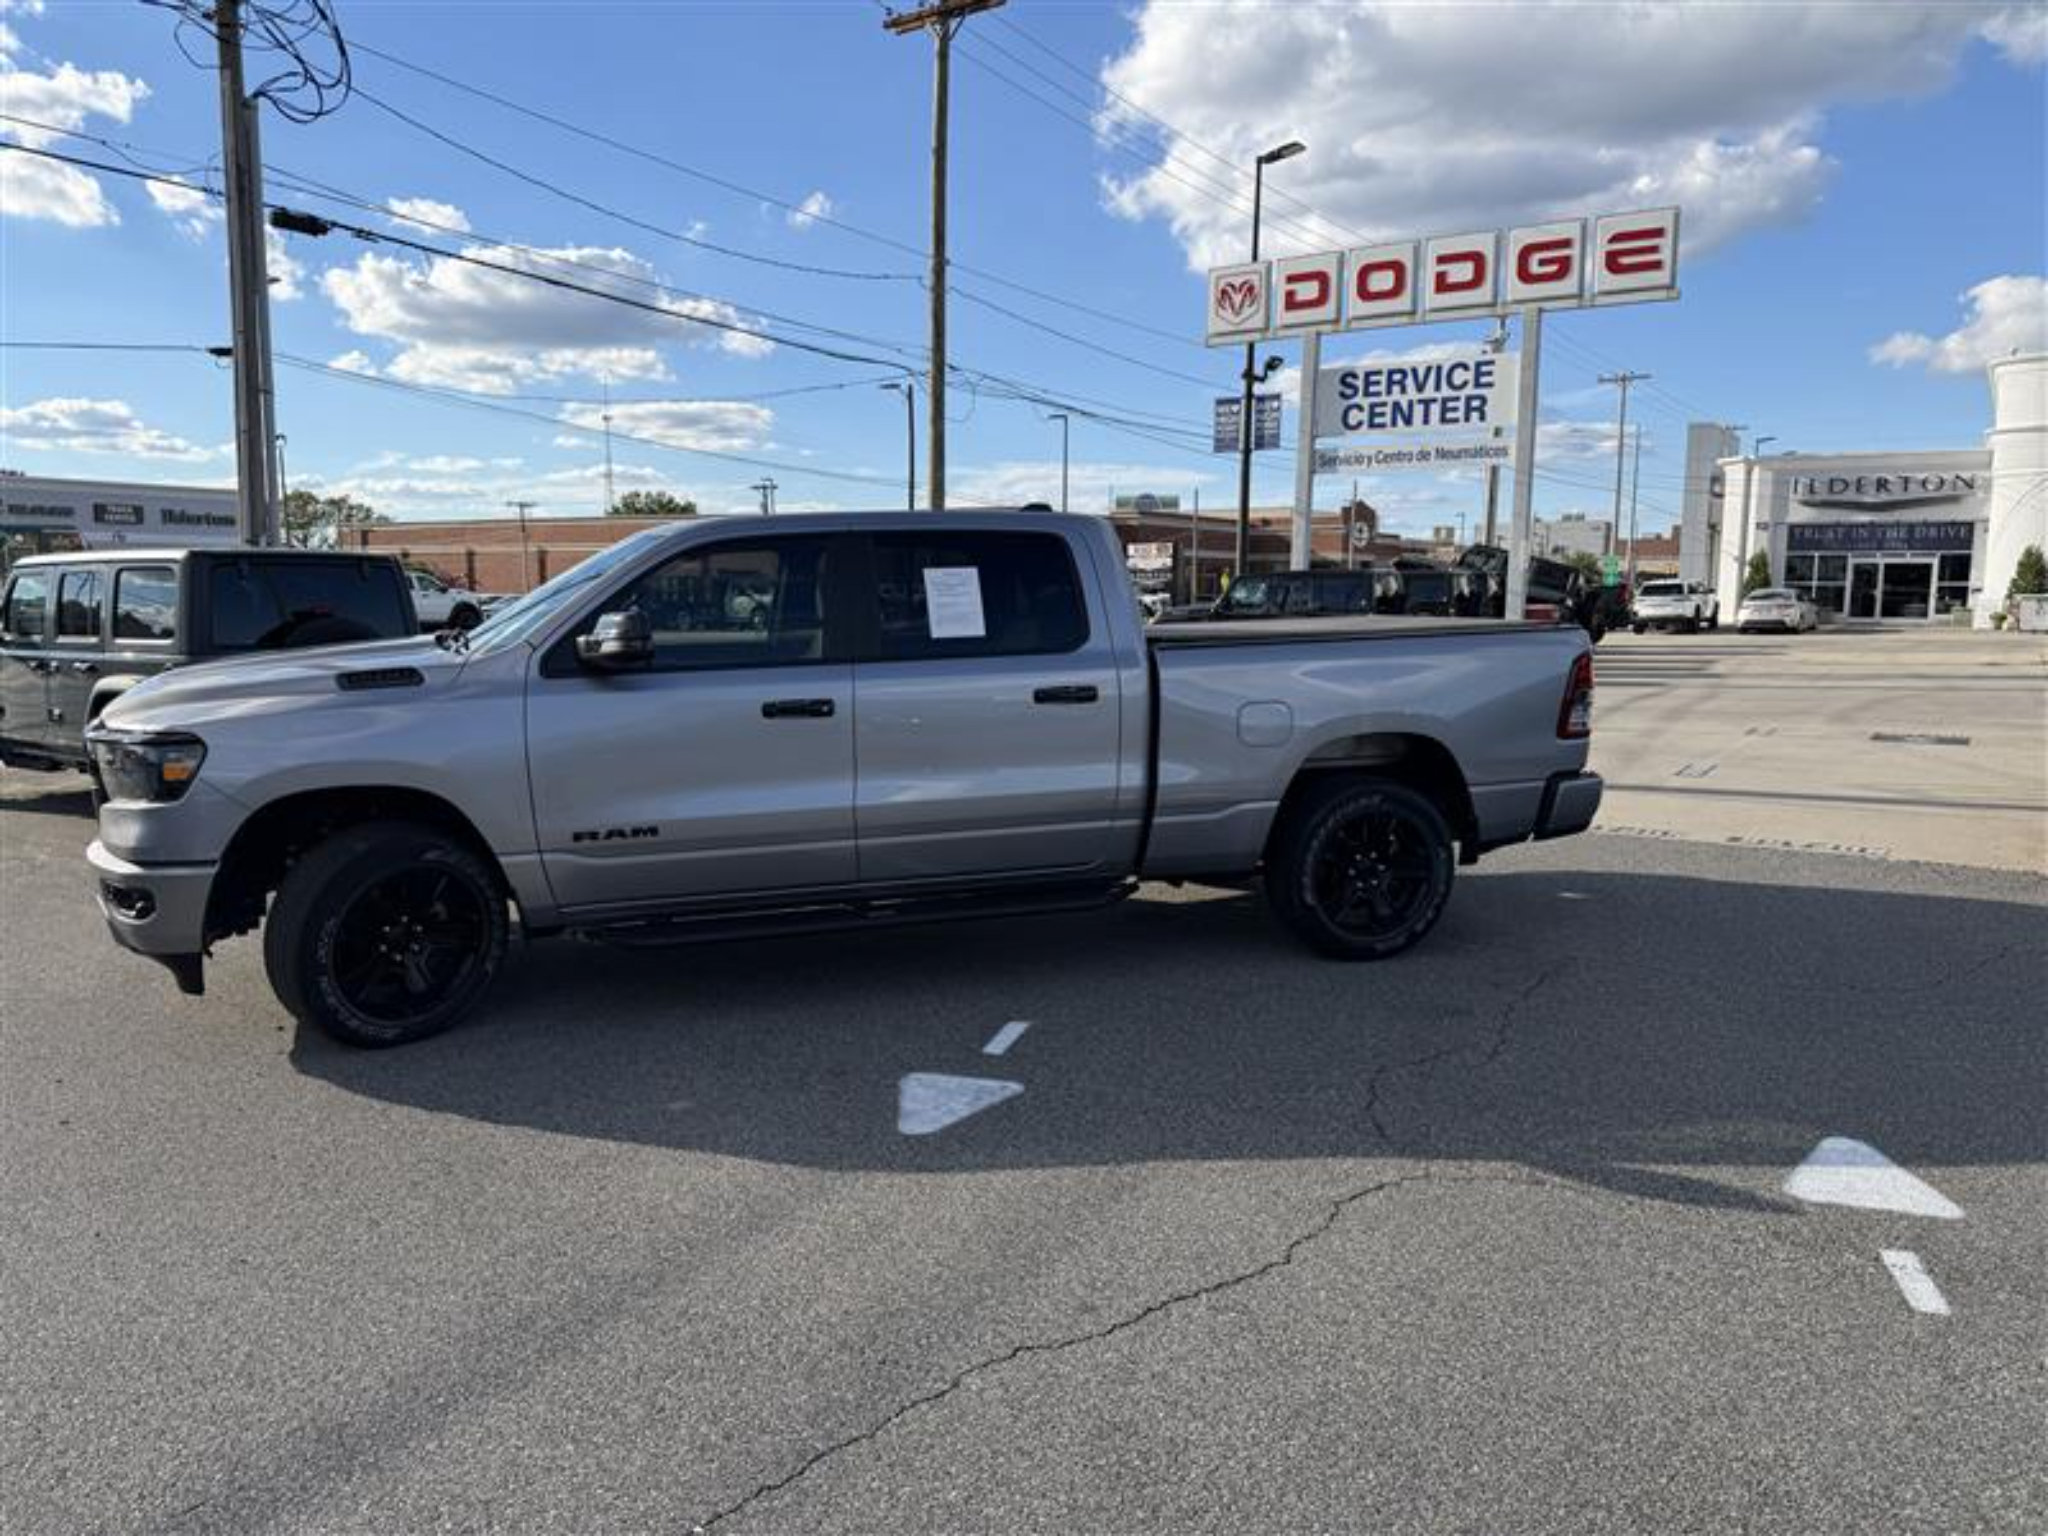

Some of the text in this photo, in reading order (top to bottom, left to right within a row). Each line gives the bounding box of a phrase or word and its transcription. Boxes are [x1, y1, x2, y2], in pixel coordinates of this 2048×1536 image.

[1283, 227, 1666, 312] DODGE
[1338, 360, 1496, 401] SERVICE
[1340, 394, 1488, 432] CENTER
[1318, 451, 1365, 468] Servicio
[1365, 454, 1373, 468] y
[1374, 449, 1413, 465] Centro
[1415, 448, 1432, 462] de
[1793, 473, 1976, 496] ILDERTON
[572, 825, 659, 843] RAM
